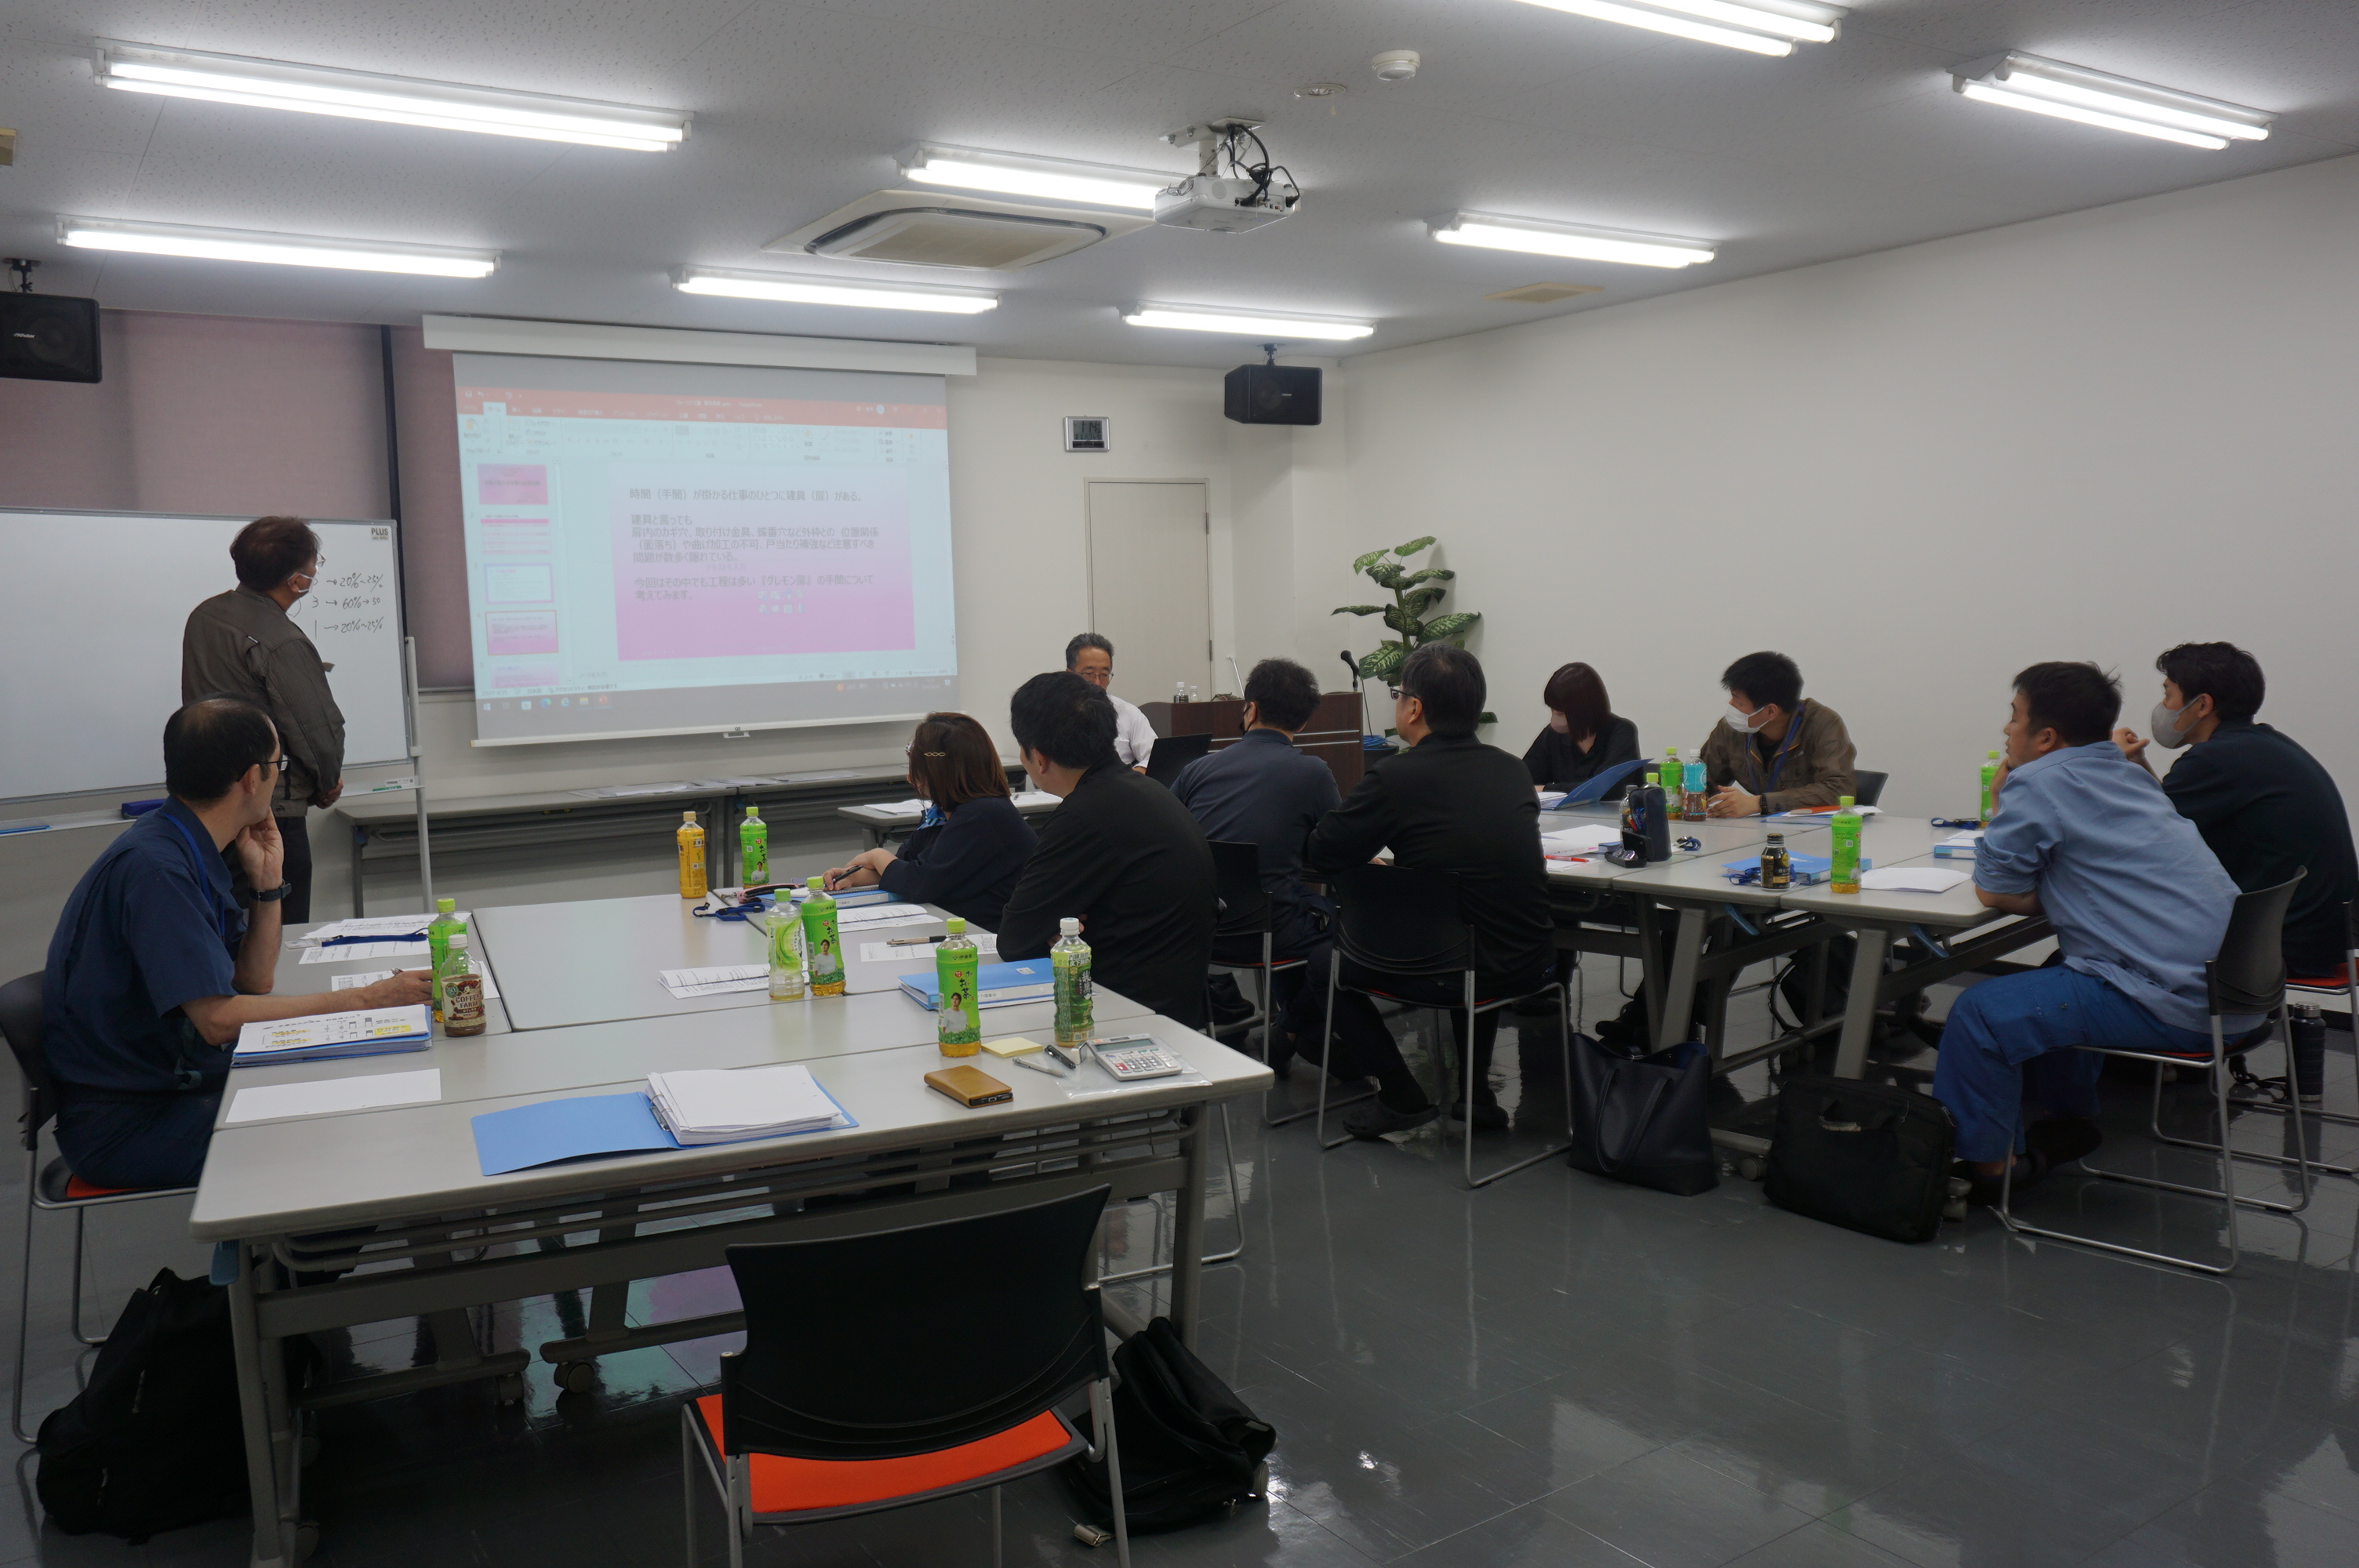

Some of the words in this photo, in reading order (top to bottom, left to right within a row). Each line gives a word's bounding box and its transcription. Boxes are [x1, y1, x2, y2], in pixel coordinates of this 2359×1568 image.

[631, 514, 692, 526] 建具と言っても
[841, 528, 879, 539] 位置関係
[633, 551, 738, 563] 問題が数多く隠れている。
[635, 590, 693, 601] 考えてみます。
[959, 978, 972, 1000] お茶
[460, 1000, 478, 1009] FARM
